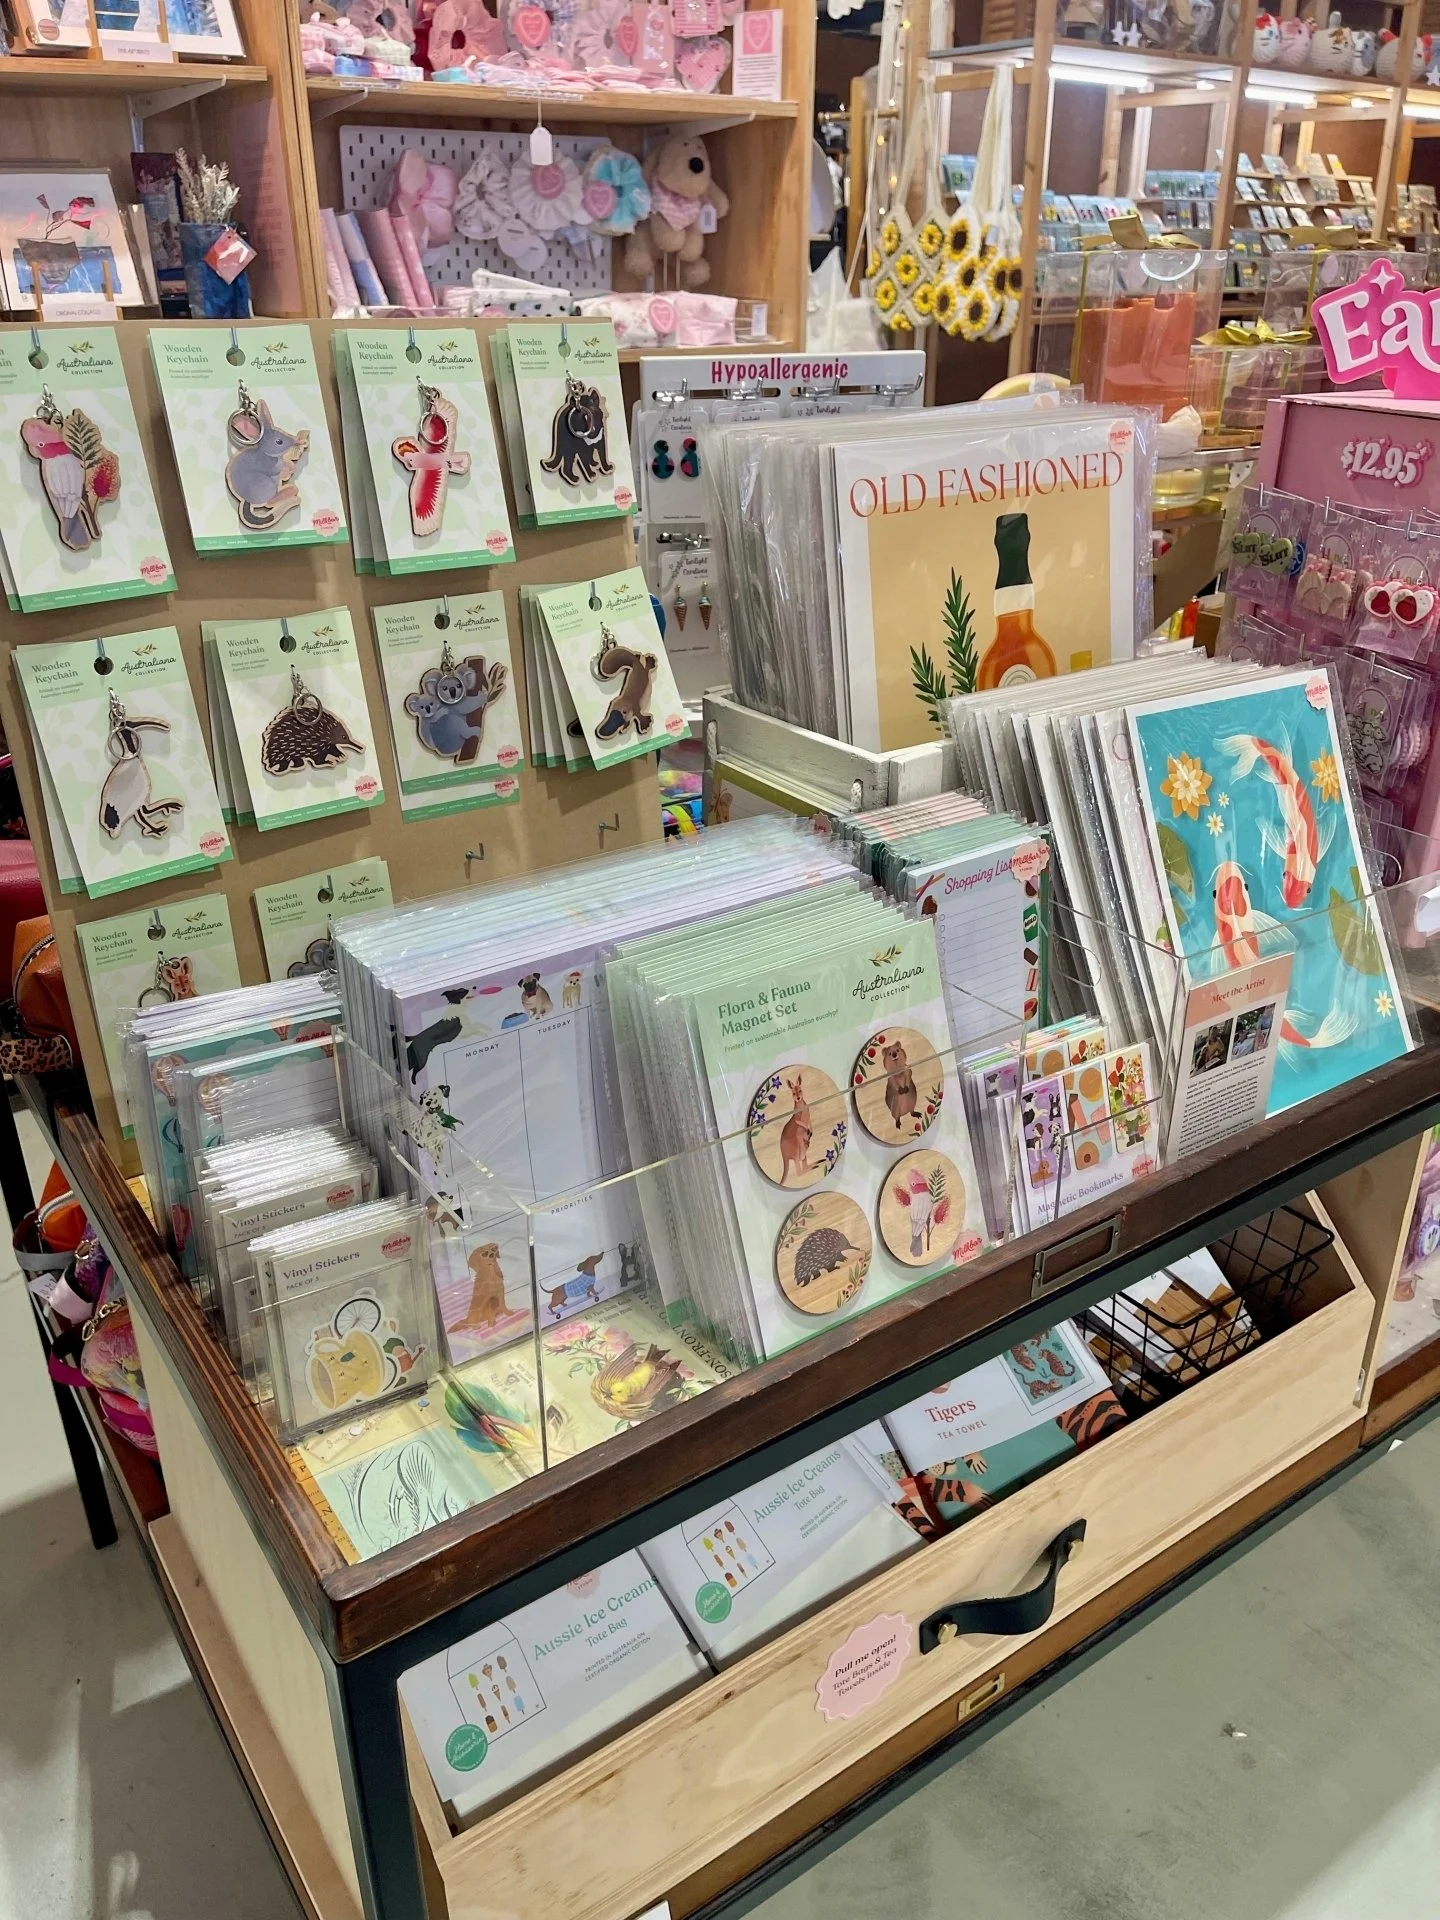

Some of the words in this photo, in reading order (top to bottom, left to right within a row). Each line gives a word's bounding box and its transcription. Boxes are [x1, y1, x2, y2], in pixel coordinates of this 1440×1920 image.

[1319, 291, 1440, 373] Ea
[164, 344, 202, 353] Wooden
[356, 341, 388, 350] Wooden
[518, 348, 547, 357] Keychain
[56, 357, 113, 372] Australiana
[166, 354, 209, 365] Keychain
[250, 356, 307, 370] Australiana
[358, 351, 394, 361] Keychain
[427, 355, 474, 367] Australiana
[574, 350, 612, 362] Australiana
[711, 358, 849, 383] Hypoallergenic
[1341, 440, 1420, 485] $12.95
[849, 473, 927, 518] OLD
[938, 450, 1123, 508] FASHIONED
[1259, 548, 1289, 567] SLUT
[548, 600, 574, 612] Wooden
[605, 593, 644, 610] Australiana
[383, 615, 415, 625] Wooden
[551, 608, 579, 621] Keychain
[386, 624, 420, 635] Keychain
[453, 616, 501, 631] Australiana
[226, 637, 259, 648] Wooden
[301, 638, 349, 654] Australiana
[229, 647, 265, 658] Keychain
[31, 660, 71, 673] Wooden
[121, 657, 177, 675] Australiana
[135, 667, 166, 677] COLLECTION
[35, 670, 79, 685] Keychain
[944, 869, 993, 896] Shopping
[265, 892, 298, 905] Wooden
[338, 886, 385, 902] Australiana
[267, 901, 304, 913] Keychain
[171, 921, 224, 940] Australiana
[1024, 915, 1037, 930] MILO
[91, 930, 128, 944] Wooden
[93, 938, 134, 953] Keychain
[852, 965, 925, 1000] Australiana
[718, 999, 755, 1019] Flora
[758, 991, 769, 1006] &
[770, 980, 812, 1001] Fauna
[870, 983, 910, 1002] COLLECTION
[1211, 991, 1230, 1005] Meet
[1230, 987, 1243, 1000] the
[1244, 978, 1266, 993] Artist
[537, 1019, 572, 1035] TUESDAY
[721, 1010, 773, 1037] Magnet
[775, 1001, 798, 1018] Set
[724, 1041, 745, 1053] Printed
[745, 1039, 754, 1048] on
[755, 1027, 786, 1043] sustainable
[787, 1018, 815, 1031] Australian
[815, 1008, 839, 1022] eucalypt
[465, 1042, 500, 1059] MONDAY
[1078, 1171, 1124, 1198] Bookmarks
[551, 1195, 594, 1216] PRIORITIES
[231, 1213, 260, 1230] Vinyl
[262, 1202, 306, 1221] Stickers
[952, 1237, 983, 1260] Milkbar
[282, 1263, 313, 1280] Vinyl
[315, 1250, 360, 1270] Stickers
[286, 1281, 303, 1291] PACK
[924, 1399, 977, 1424] Tigers
[937, 1431, 955, 1440] TEA
[956, 1419, 988, 1435] TOWEL
[753, 1489, 790, 1523] Aussie
[786, 1477, 806, 1496] Ice
[803, 1450, 842, 1481] Creams
[793, 1494, 811, 1511] Tote
[810, 1484, 826, 1500] Bag
[533, 1622, 584, 1661] Aussie
[583, 1608, 607, 1628] Ice
[607, 1576, 659, 1612] Creams
[585, 1630, 609, 1648] Tote
[607, 1617, 628, 1635] Bag
[584, 1657, 605, 1673] PRINTED
[605, 1653, 612, 1661] IN
[611, 1637, 637, 1657] AUSTRALIA
[636, 1631, 646, 1639] ON
[584, 1663, 609, 1681] CERTIFIED
[608, 1648, 632, 1666] ORGANIC
[631, 1637, 651, 1651] COTTON
[834, 1660, 853, 1678] Pull
[854, 1652, 870, 1666] me
[870, 1634, 897, 1658] open!
[832, 1675, 851, 1691] Tote
[851, 1663, 873, 1679] Bags
[874, 1656, 881, 1665] &
[883, 1647, 897, 1661] Tea
[837, 1675, 866, 1697] Towels
[866, 1660, 891, 1678] inside
